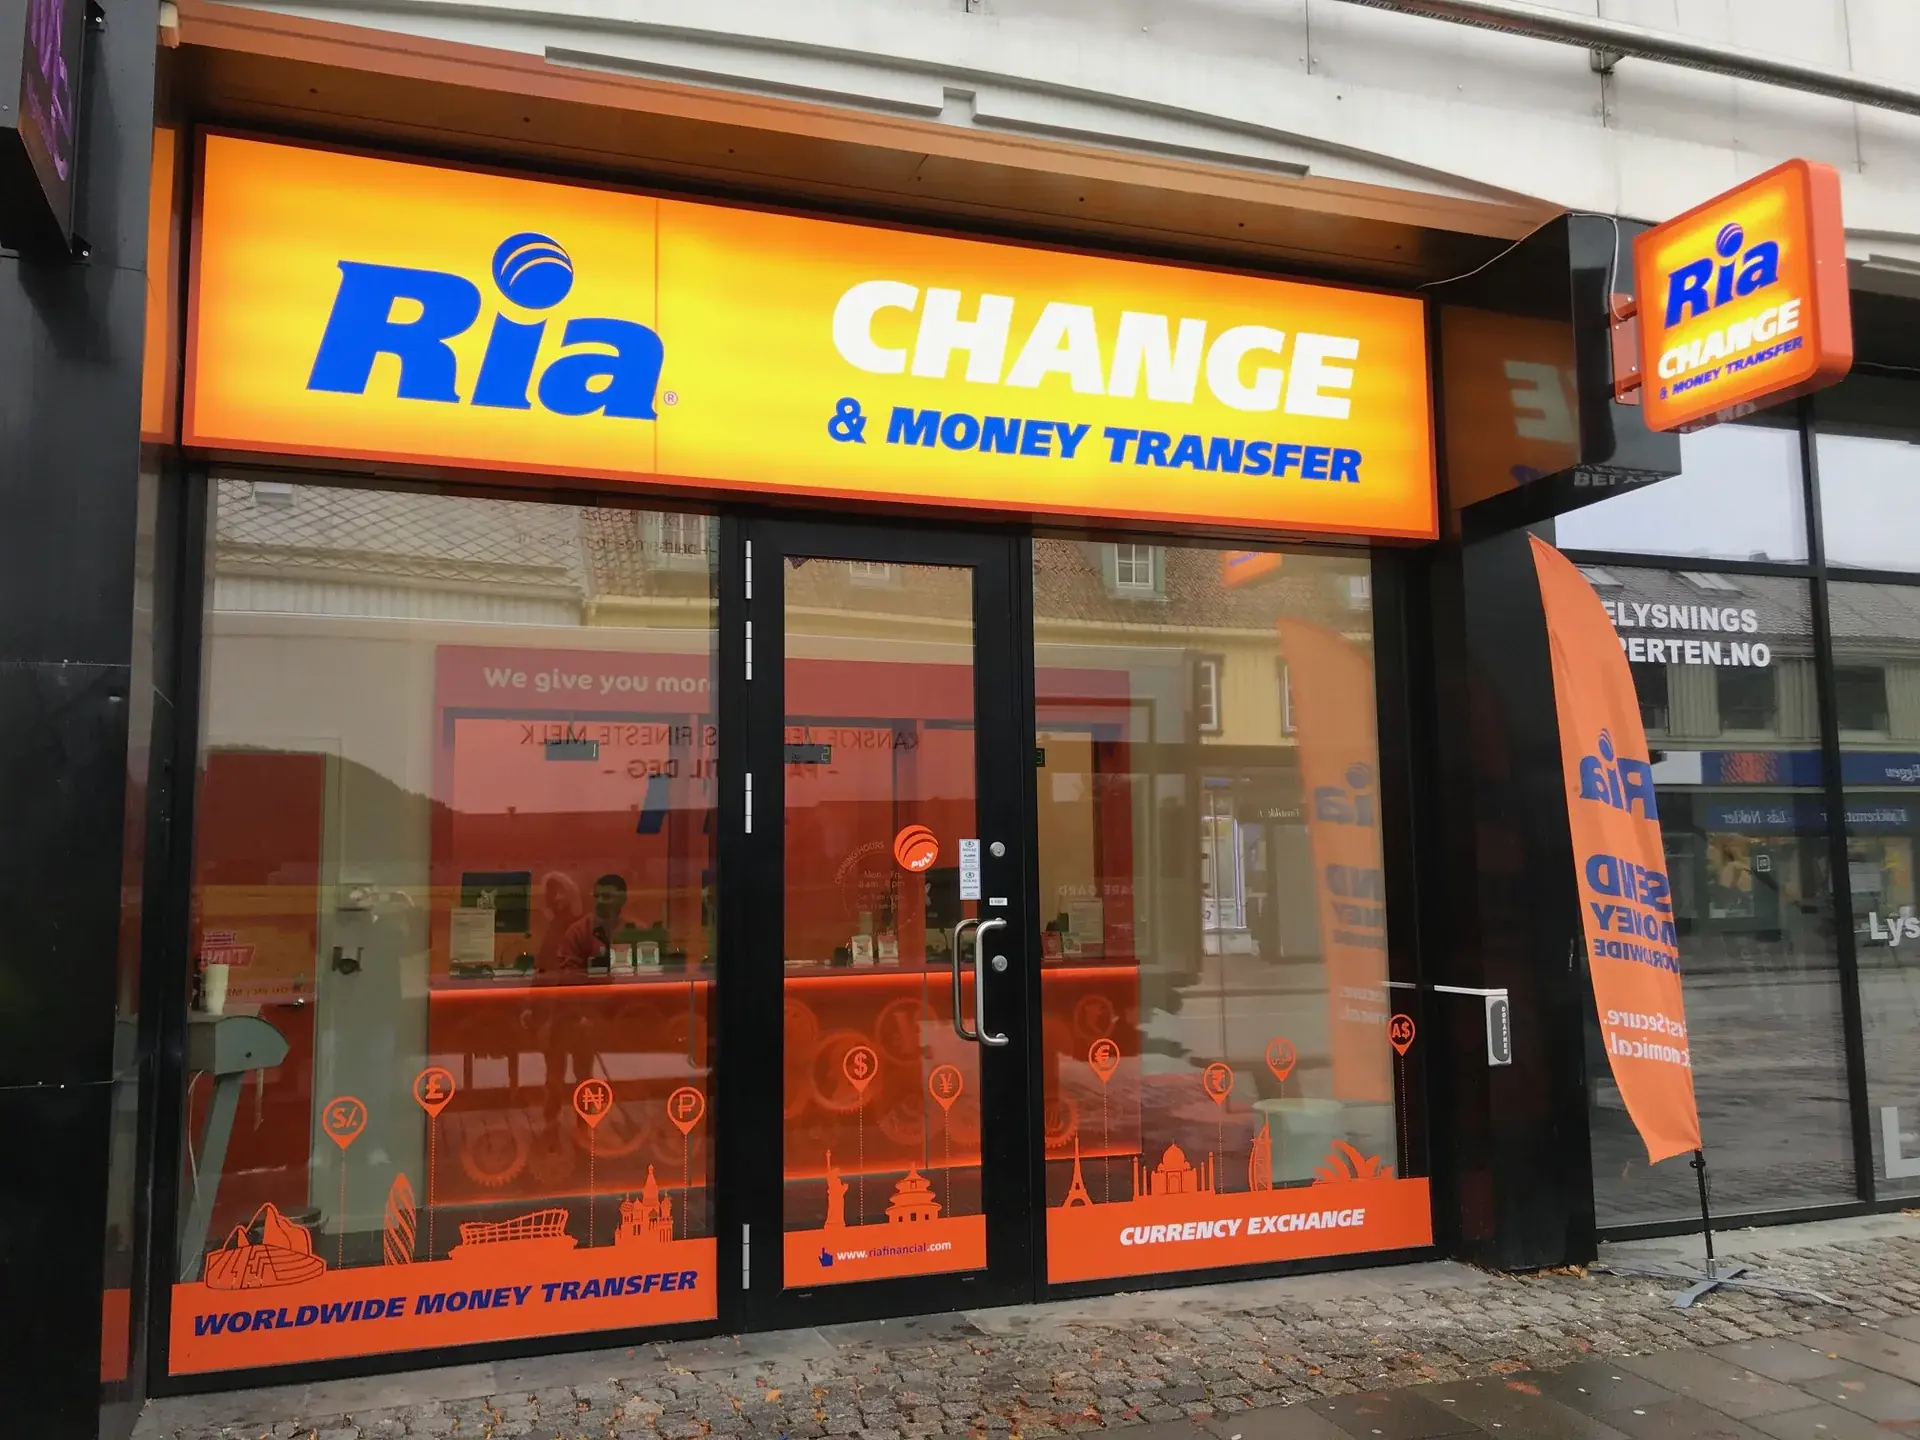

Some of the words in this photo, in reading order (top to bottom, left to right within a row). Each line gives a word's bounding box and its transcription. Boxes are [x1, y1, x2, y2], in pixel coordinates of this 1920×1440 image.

[1664, 222, 1779, 329] Ria
[306, 231, 665, 421] Ria
[832, 280, 1360, 420] CHANGE
[1658, 299, 1801, 379] CHANGE
[1672, 367, 1722, 394] MONEY
[1726, 336, 1803, 375] TRANSFER
[827, 397, 868, 444] &
[885, 406, 1093, 458] MONEY
[1102, 427, 1363, 484] TRANSFER
[1601, 601, 1759, 633] ELYSNINGS
[483, 667, 527, 688] We
[534, 668, 594, 692] give
[599, 675, 649, 694] you
[656, 676, 712, 693] mor
[911, 851, 934, 869] PULL
[837, 1241, 952, 1260] www.riafinancial.com
[1119, 1218, 1242, 1246] CURRENCY
[1247, 1208, 1366, 1235] EXCHANGE
[194, 1297, 406, 1336] WORLDWIDE
[414, 1285, 532, 1315] MONEY
[541, 1270, 698, 1303] TRANSFER
